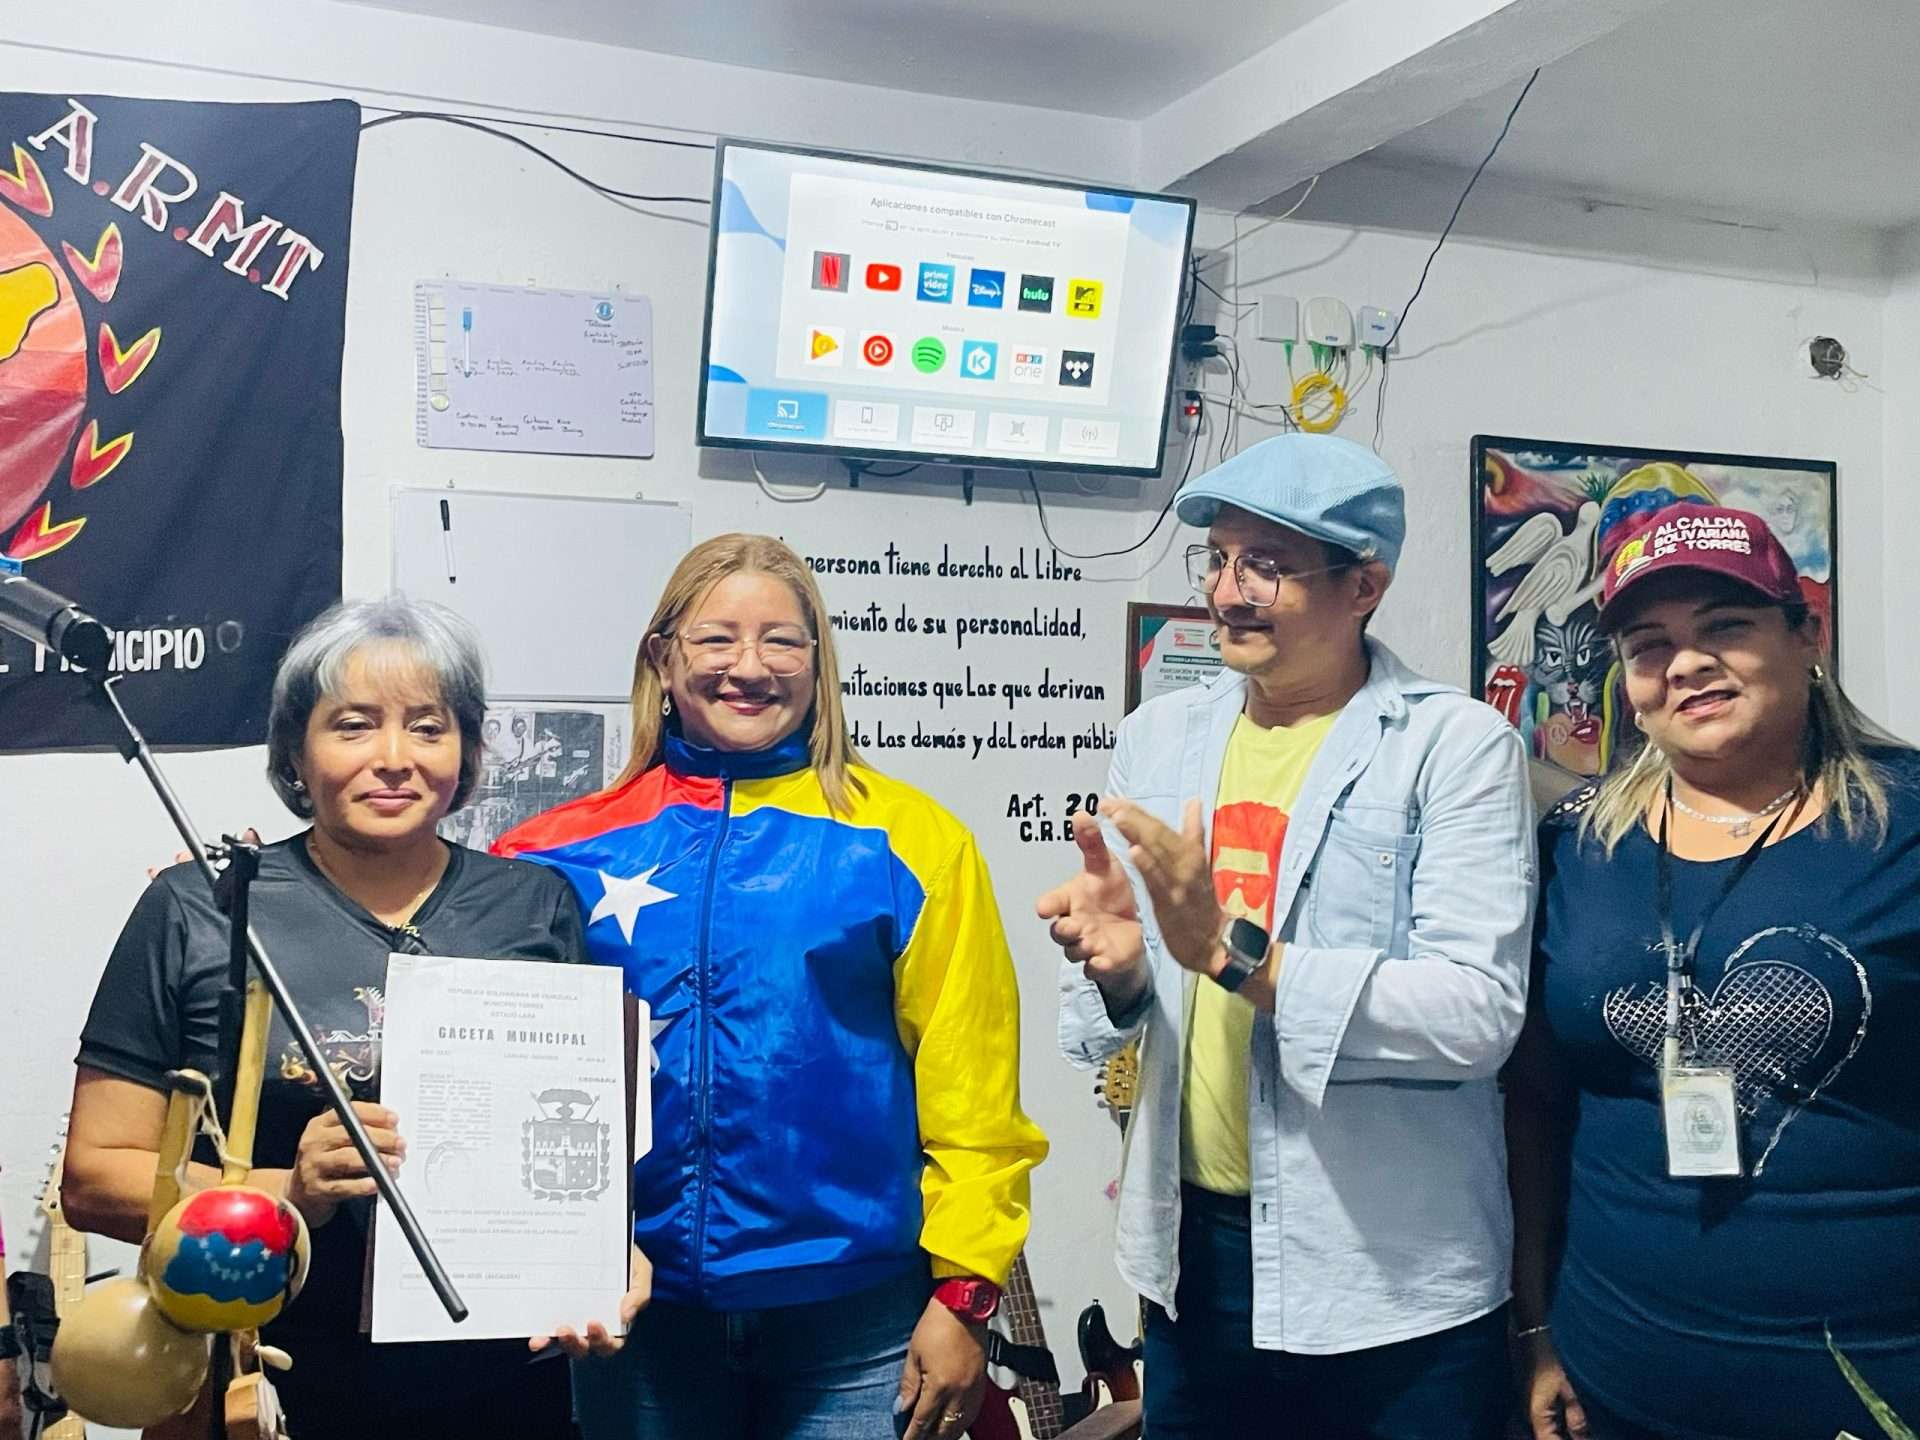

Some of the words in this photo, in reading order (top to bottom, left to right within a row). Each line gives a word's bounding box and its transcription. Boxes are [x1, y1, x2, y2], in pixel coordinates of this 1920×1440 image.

[870, 197, 928, 213] Aplicaciones
[930, 204, 984, 220] compatibles
[985, 211, 1002, 221] con
[1004, 213, 1056, 229] Chromecast
[923, 269, 949, 280] prime
[923, 279, 949, 290] video
[1022, 287, 1049, 301] hulu
[1014, 366, 1041, 378] one
[1655, 517, 1747, 538] ALCALDIA
[1654, 528, 1750, 549] BOLIVARIANA
[1654, 543, 1678, 558] DE
[1685, 539, 1751, 555] TORRES
[884, 541, 932, 576] tiene
[937, 543, 1003, 579] derecho
[894, 603, 918, 633] de
[922, 617, 947, 634] su
[933, 681, 964, 710] que
[1002, 683, 1032, 710] que
[1038, 667, 1105, 701] derivan
[850, 720, 871, 748] de
[911, 720, 967, 749] demás
[971, 735, 983, 760] y
[1020, 721, 1066, 749] orden
[1006, 793, 1047, 818] Art.
[1065, 793, 1099, 817] 20
[438, 1026, 494, 1041] GACETA
[506, 1029, 587, 1046] MUNICIPAL
